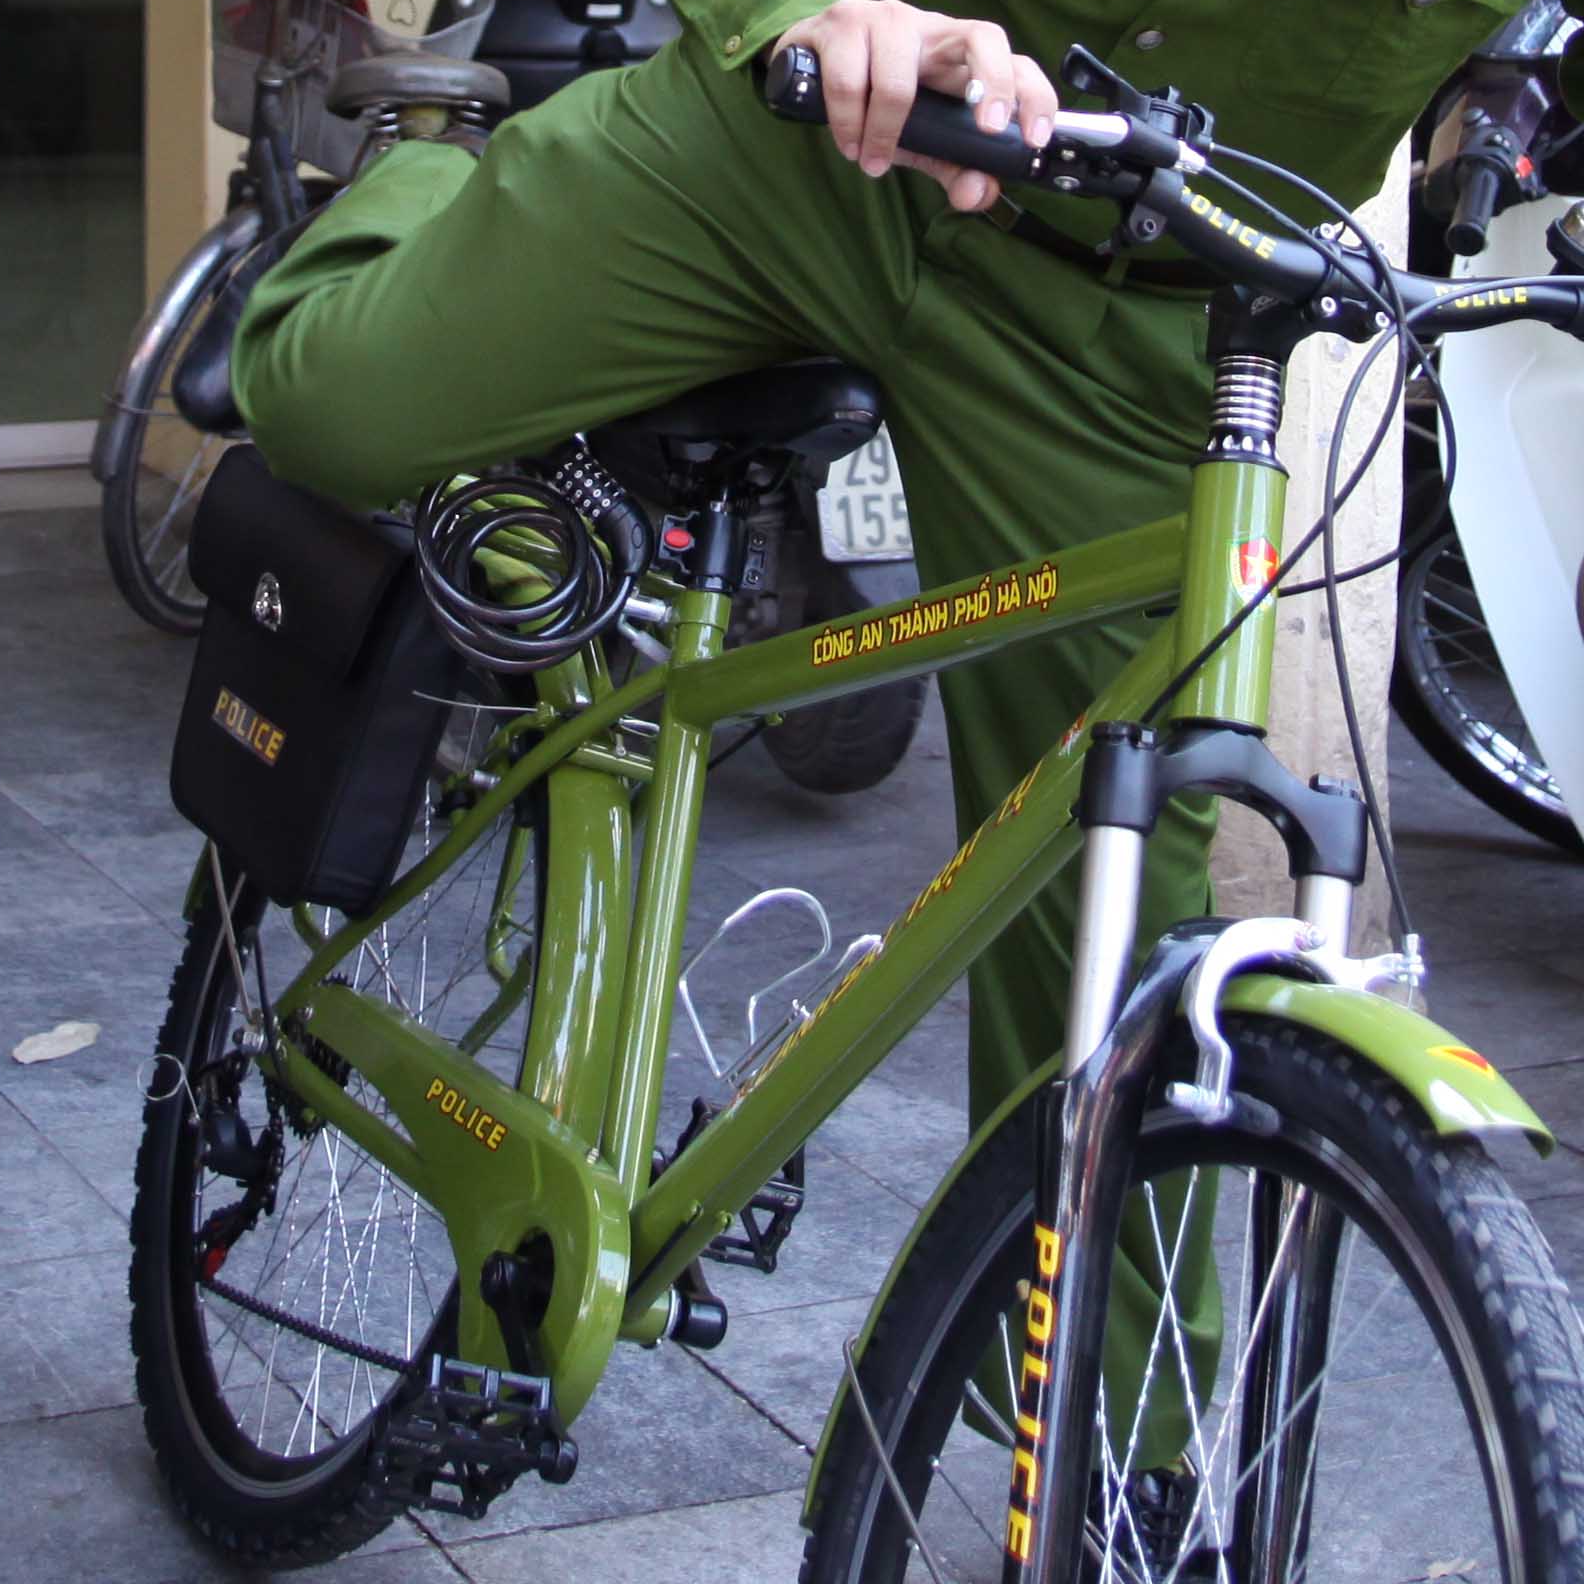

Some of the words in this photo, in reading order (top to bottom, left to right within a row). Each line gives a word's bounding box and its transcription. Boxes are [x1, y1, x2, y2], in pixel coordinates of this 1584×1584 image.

[1181, 184, 1279, 261] OLICE
[812, 627, 855, 666] CÔNG
[858, 619, 884, 653] AN
[888, 600, 949, 645] THÀNH
[953, 574, 992, 627] PHỐ
[996, 572, 1022, 616] HÀ
[1026, 562, 1059, 610] NỘI
[214, 687, 287, 760] POLICE
[426, 1077, 508, 1152] POLICE
[1005, 1220, 1062, 1561] POLICE
